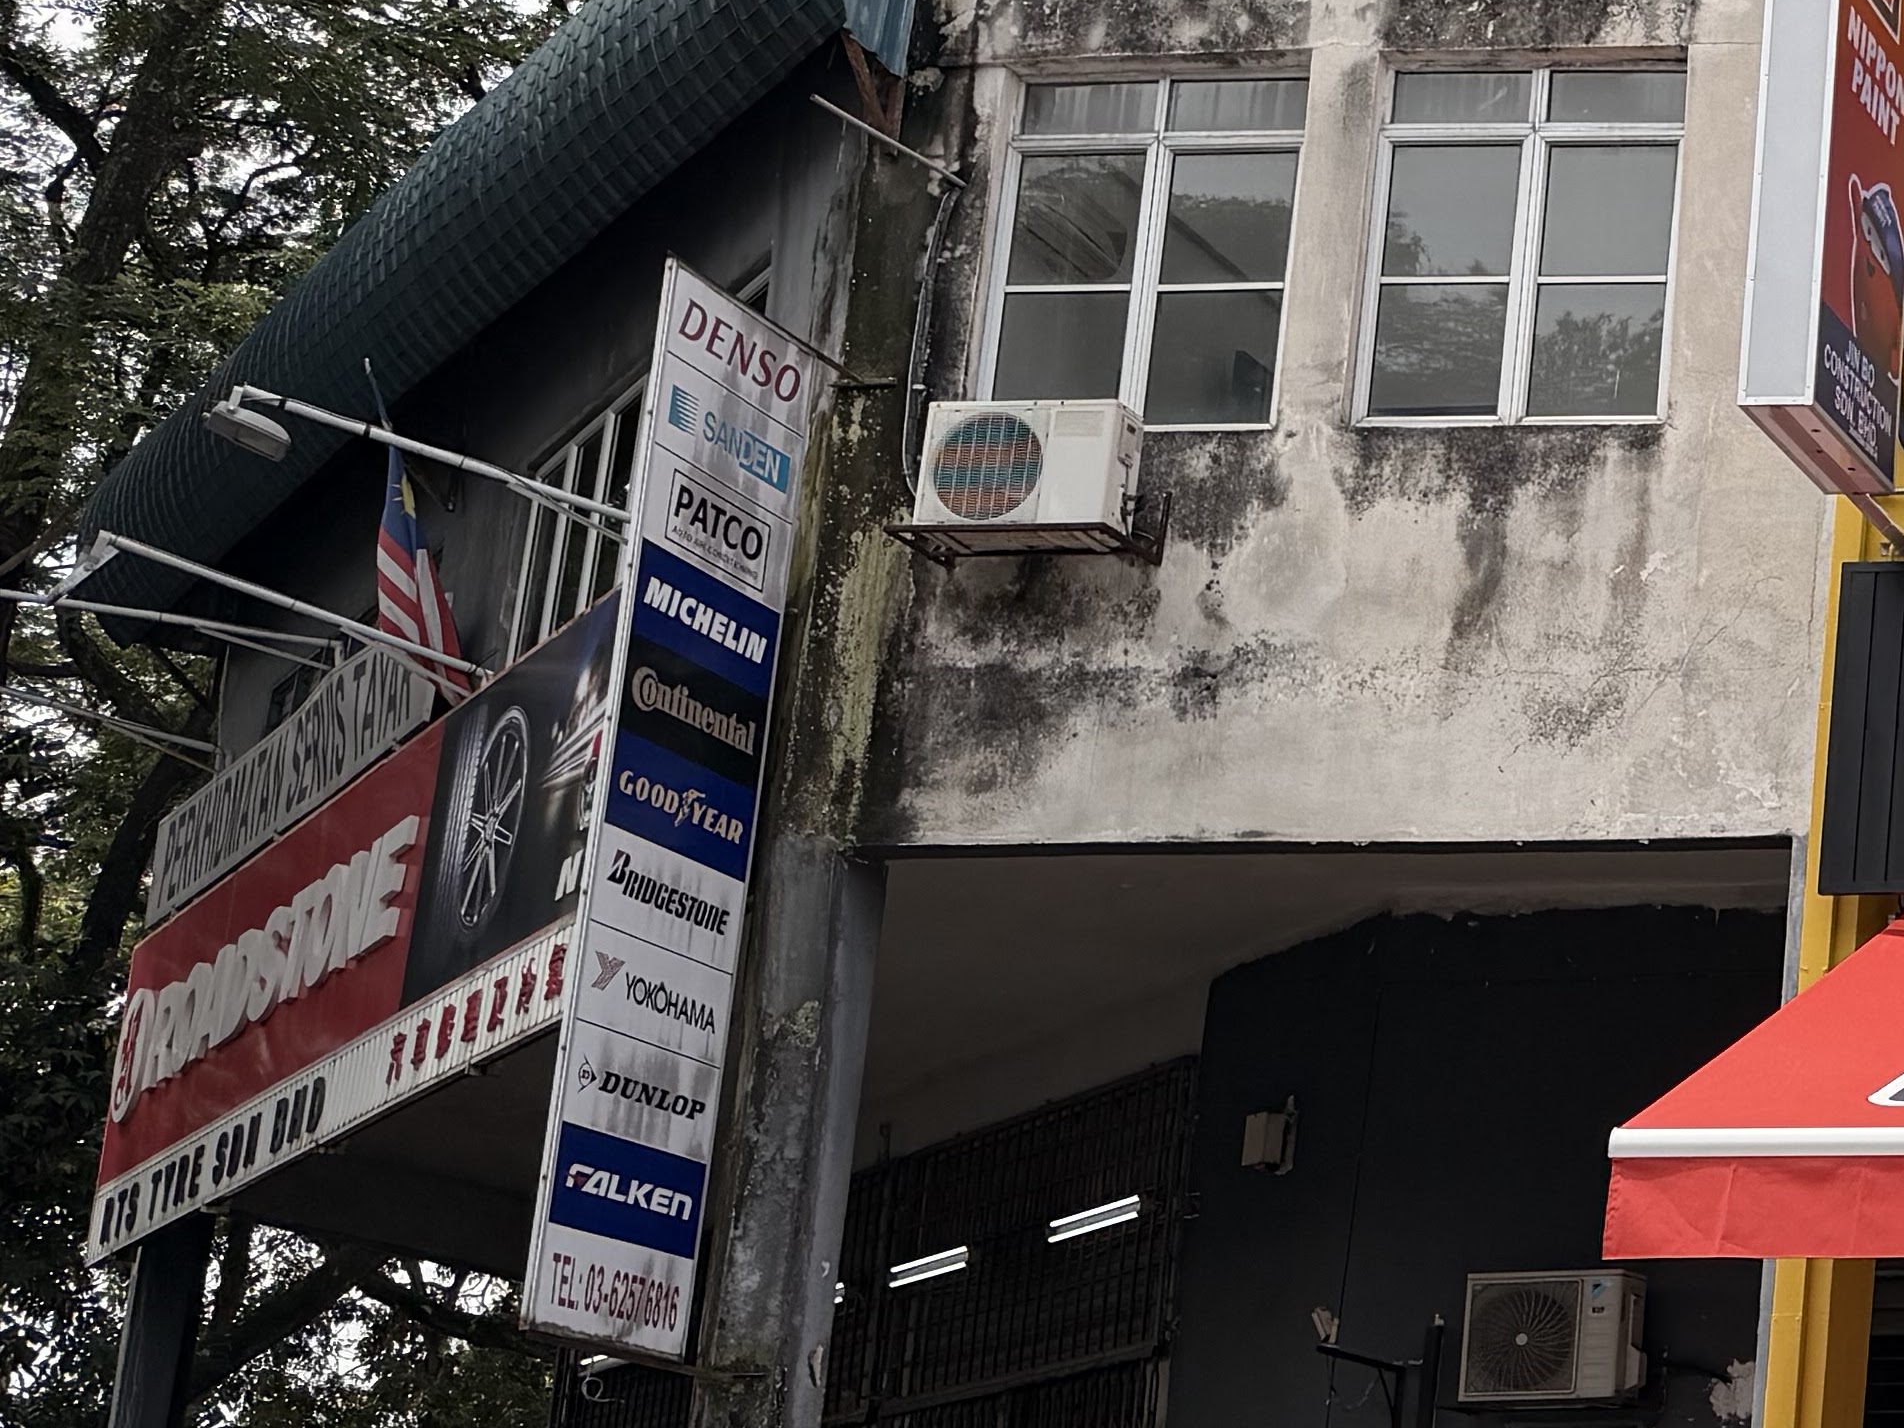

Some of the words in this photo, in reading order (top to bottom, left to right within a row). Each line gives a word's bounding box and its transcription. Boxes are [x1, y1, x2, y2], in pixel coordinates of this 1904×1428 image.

[1852, 58, 1900, 146] PAINT
[678, 298, 801, 402] DENSO
[1824, 344, 1892, 437] CONSTRUCTION
[703, 411, 781, 484] SANDEN
[673, 484, 763, 561] PATCO
[643, 576, 768, 664] MICHELIN
[285, 674, 346, 813] SERVIS
[353, 652, 411, 762] TAYAR
[631, 666, 756, 756] Continental
[619, 770, 743, 844] GOODYEAR
[607, 848, 731, 936] BRIDGESTONE
[140, 814, 420, 1093] ROADSTONE
[625, 971, 716, 1035] YOKOHAMA
[598, 1070, 706, 1120] DUNLOP
[147, 1144, 205, 1221] TYRE
[212, 1112, 263, 1187] SDN
[270, 1076, 327, 1154] BHD
[565, 1163, 693, 1221] FALKEN
